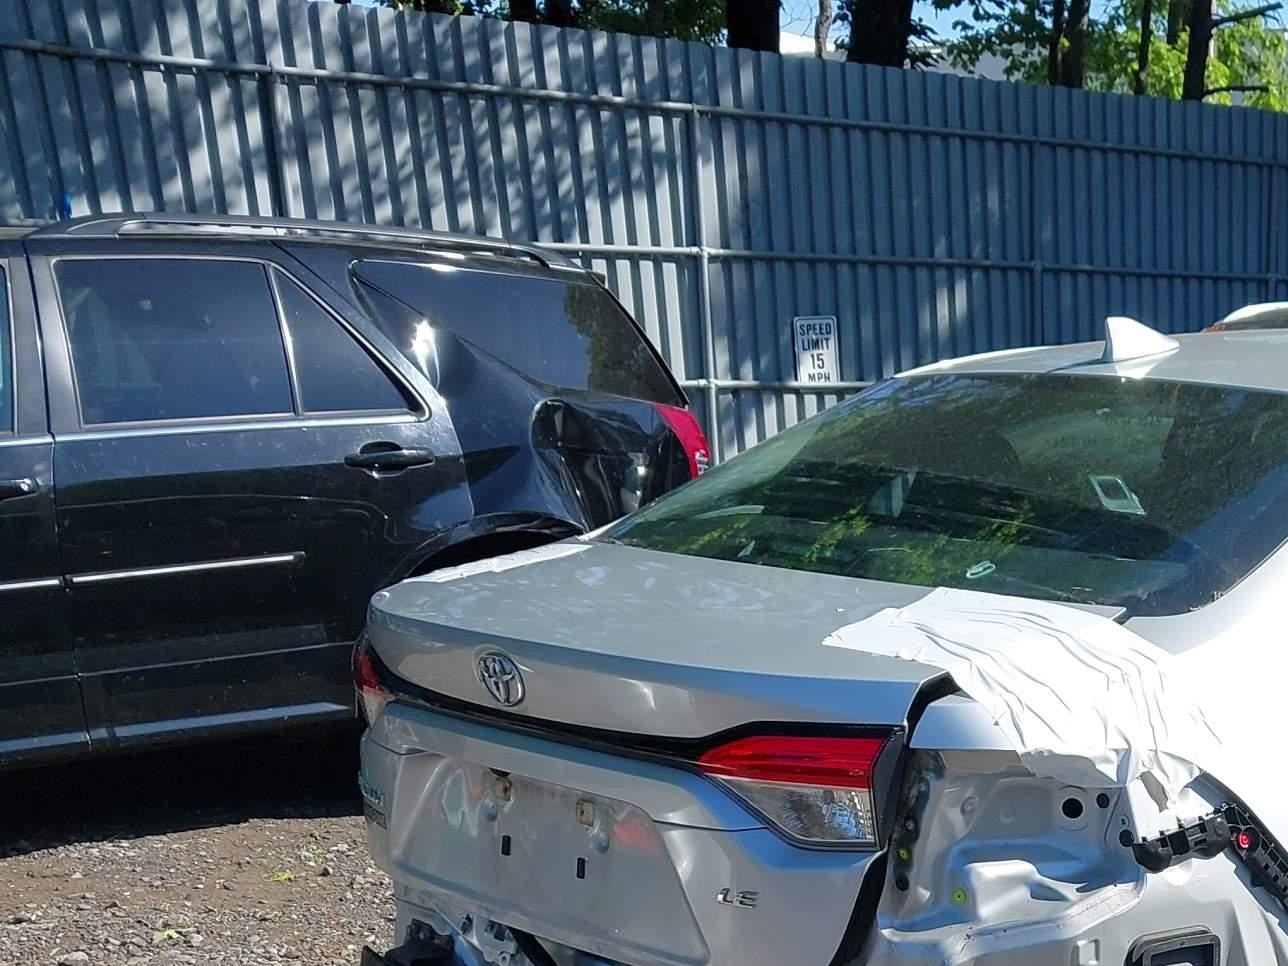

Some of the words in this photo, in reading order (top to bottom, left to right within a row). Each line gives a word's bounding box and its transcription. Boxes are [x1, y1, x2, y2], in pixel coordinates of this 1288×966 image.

[799, 322, 832, 336] SPEED
[801, 337, 831, 351] LIMIT
[810, 353, 825, 369] 15
[808, 372, 831, 383] MPH
[717, 887, 760, 909] LE
